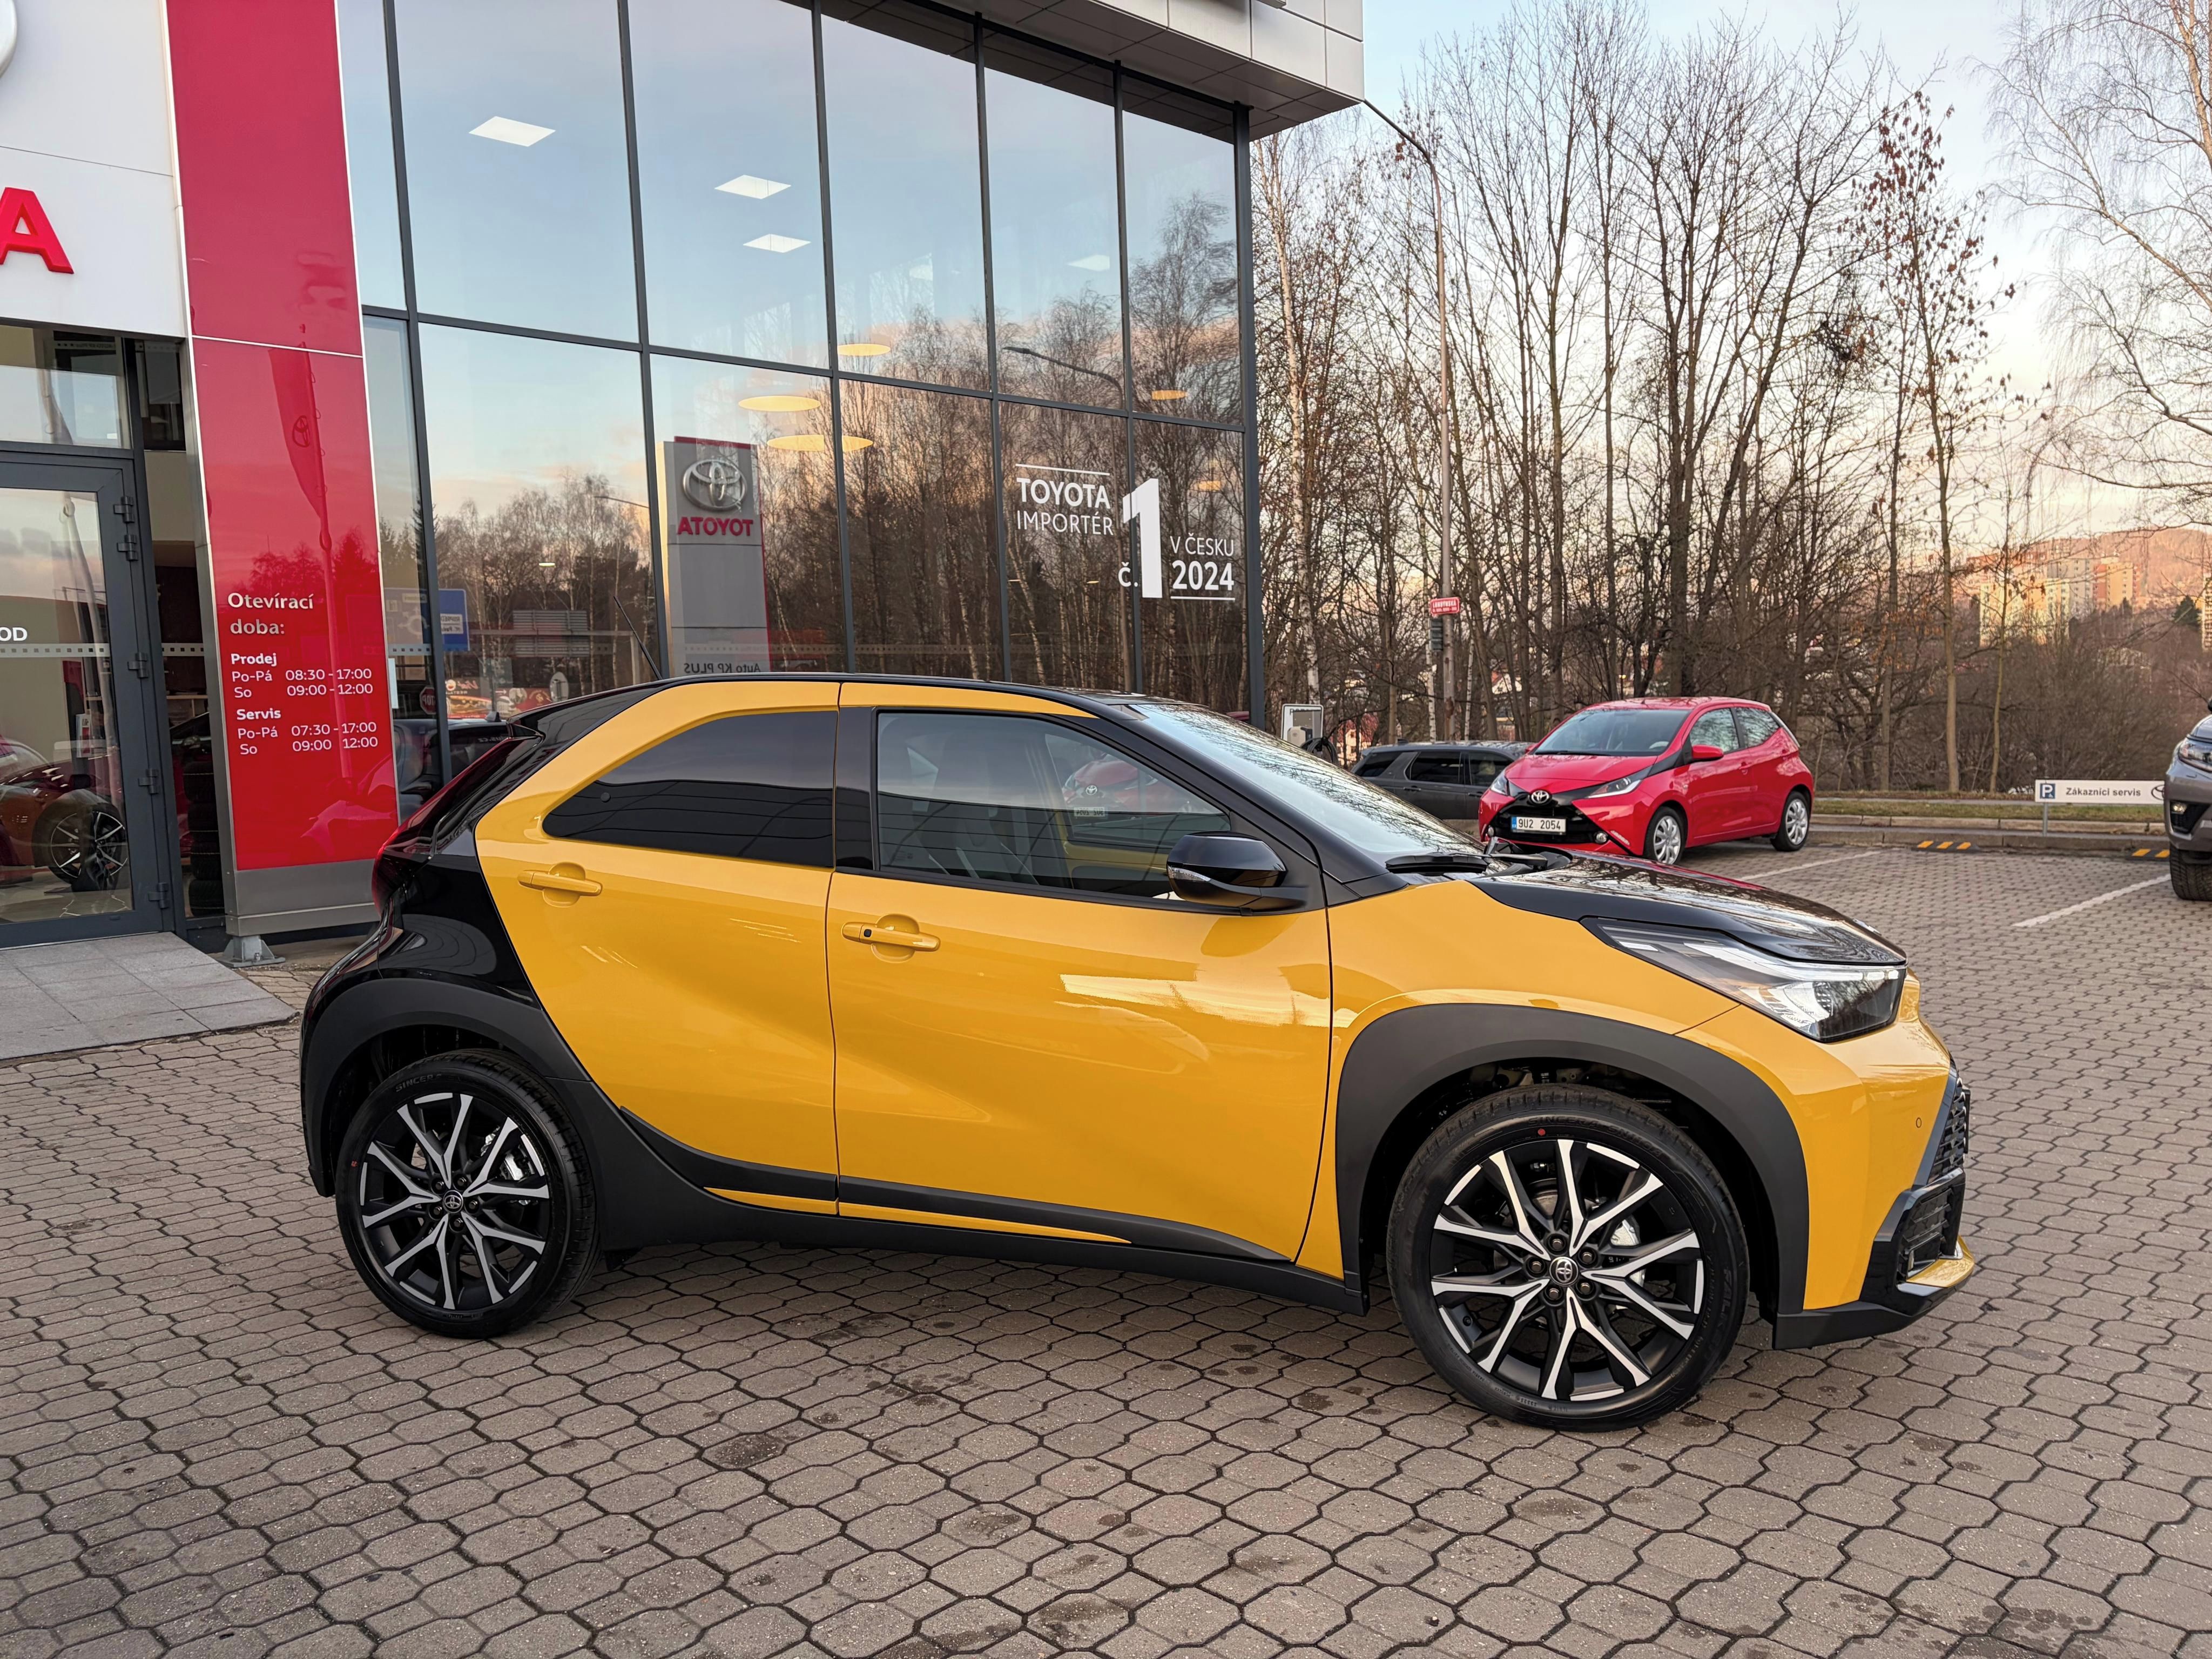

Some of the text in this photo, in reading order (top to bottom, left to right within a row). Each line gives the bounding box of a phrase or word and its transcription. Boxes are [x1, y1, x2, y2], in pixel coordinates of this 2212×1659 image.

[1016, 478, 1111, 509] TOYOTA
[1017, 510, 1113, 535] IMPORTÉR
[1123, 478, 1162, 598] 1
[1170, 532, 1234, 557] V ČESKU
[1172, 561, 1234, 590] 2024
[227, 592, 314, 609] Otevírací
[0, 626, 28, 641] OD
[230, 619, 285, 635] doba:
[231, 652, 277, 667] Prodej
[232, 670, 273, 682] Po-Pá
[285, 669, 325, 680] 08:30
[336, 669, 372, 679] 17:00
[234, 687, 252, 698] So
[287, 685, 327, 696] 09:00
[338, 683, 373, 694] 12:00
[236, 708, 281, 720] Servis
[238, 726, 278, 739] Po-Pá
[291, 724, 331, 737] 07:30
[341, 721, 377, 734] 17:00
[240, 737, 378, 754] So 09:00 12:00
[2113, 788, 2141, 797] servis
[1519, 819, 1561, 830] 9U2 2054
